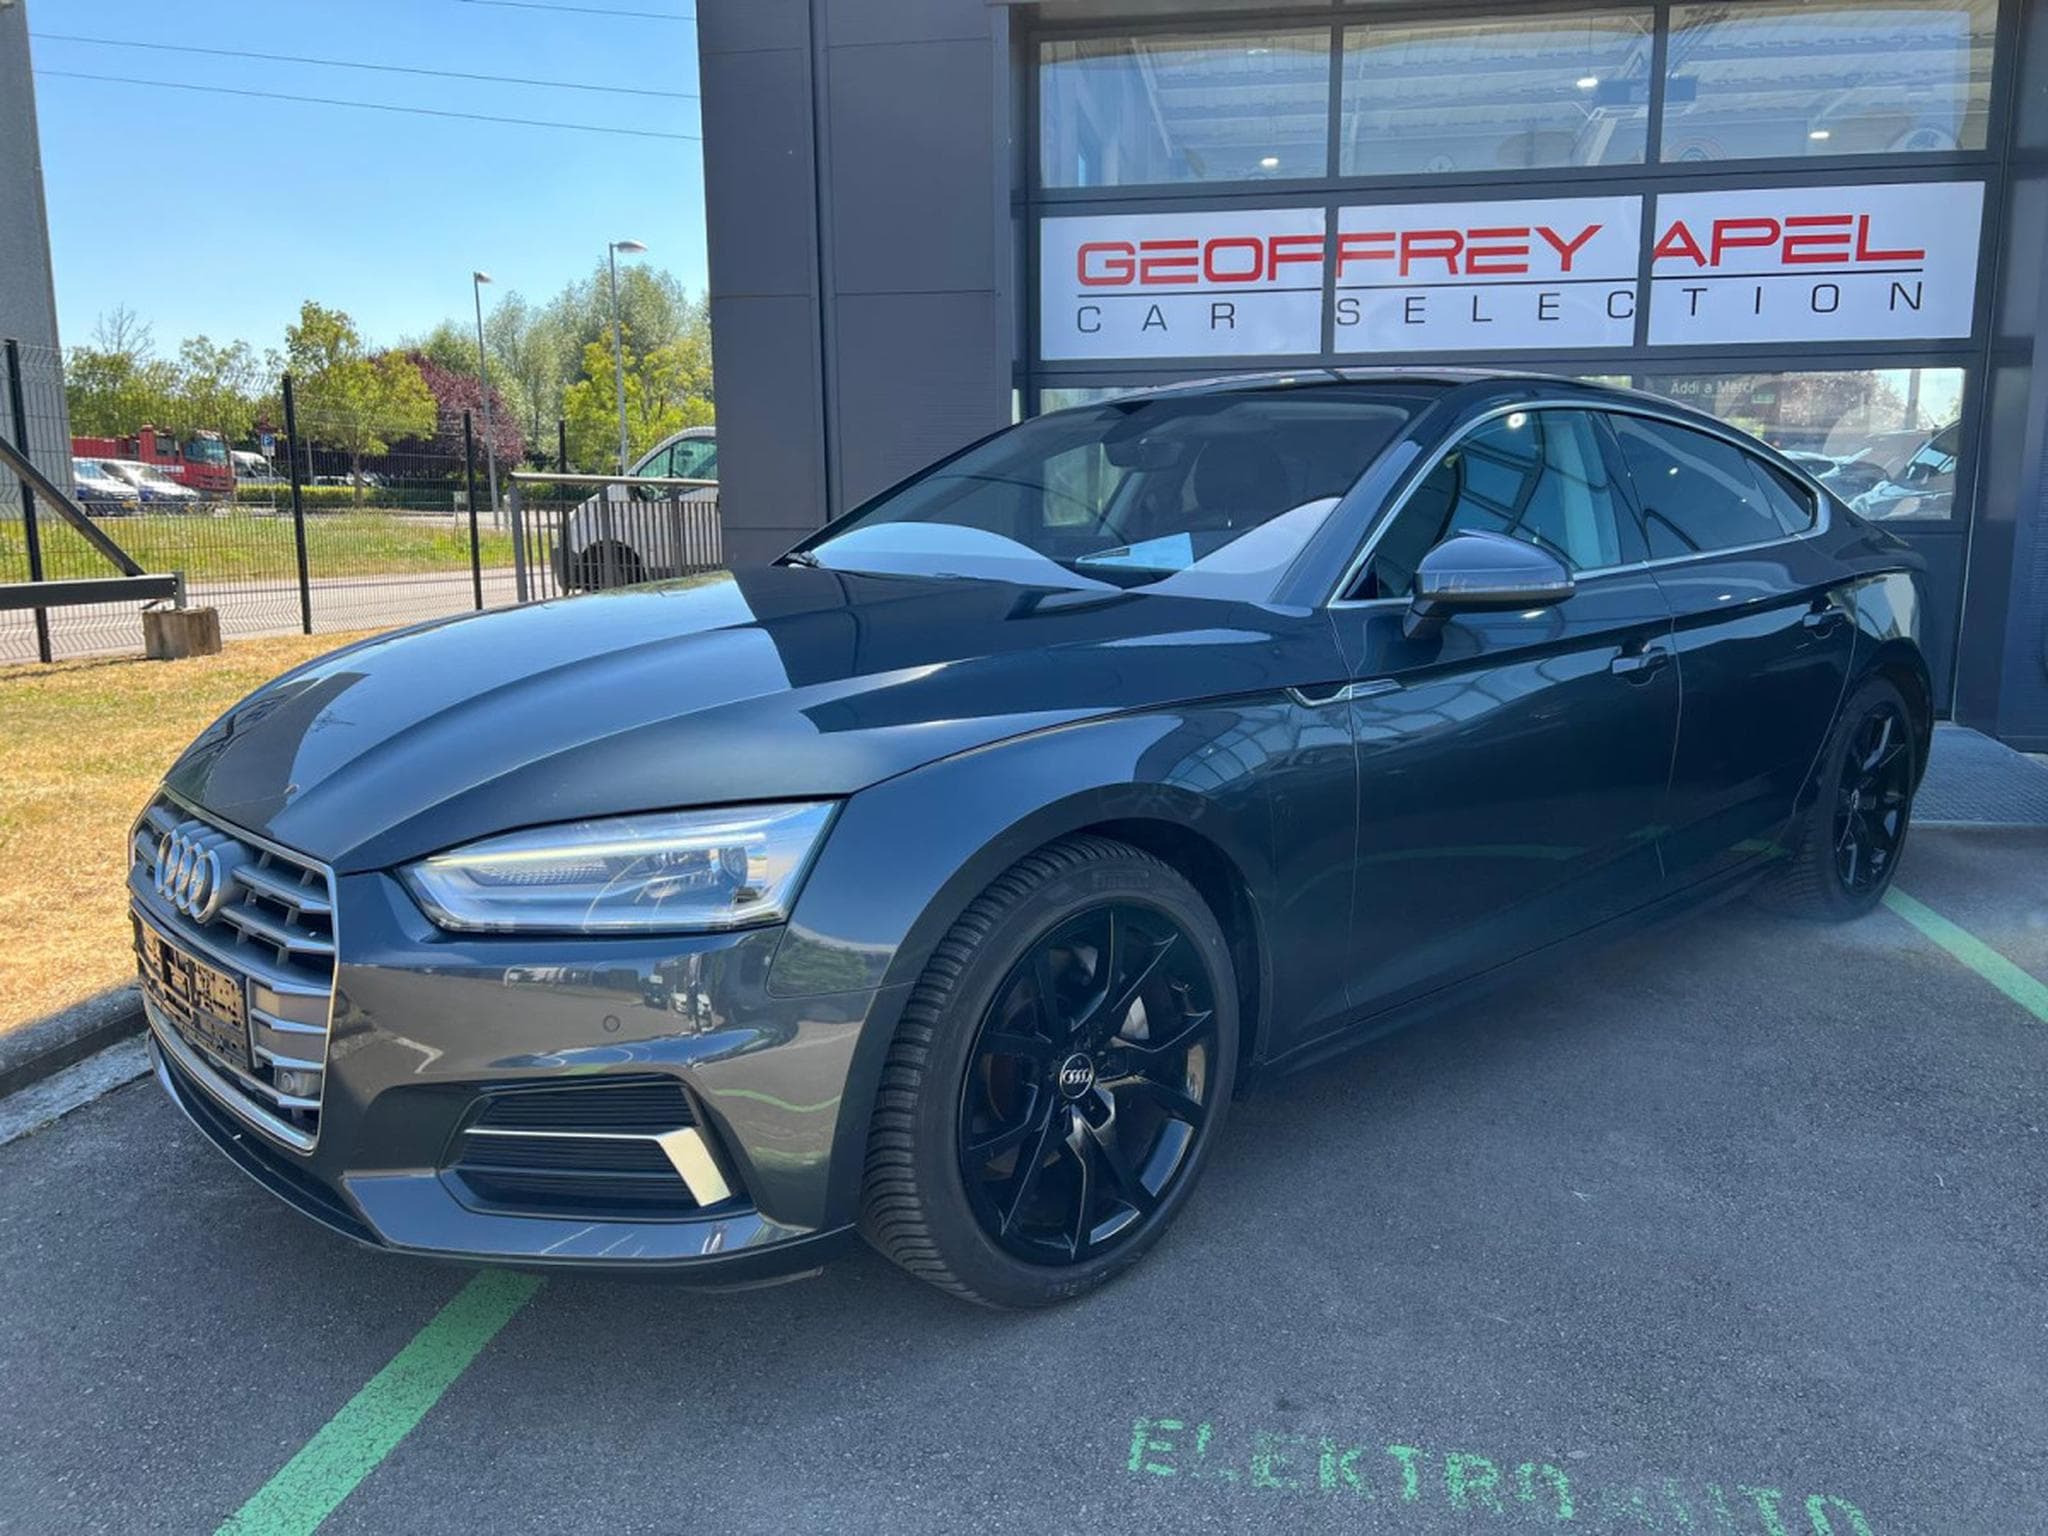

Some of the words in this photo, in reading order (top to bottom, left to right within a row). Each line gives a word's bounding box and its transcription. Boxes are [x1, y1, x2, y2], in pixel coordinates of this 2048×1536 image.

[1077, 224, 1603, 287] GEOFFREY
[1652, 214, 1925, 268] APEL
[1077, 302, 1236, 334] CAR
[1336, 281, 1923, 326] SELECTION
